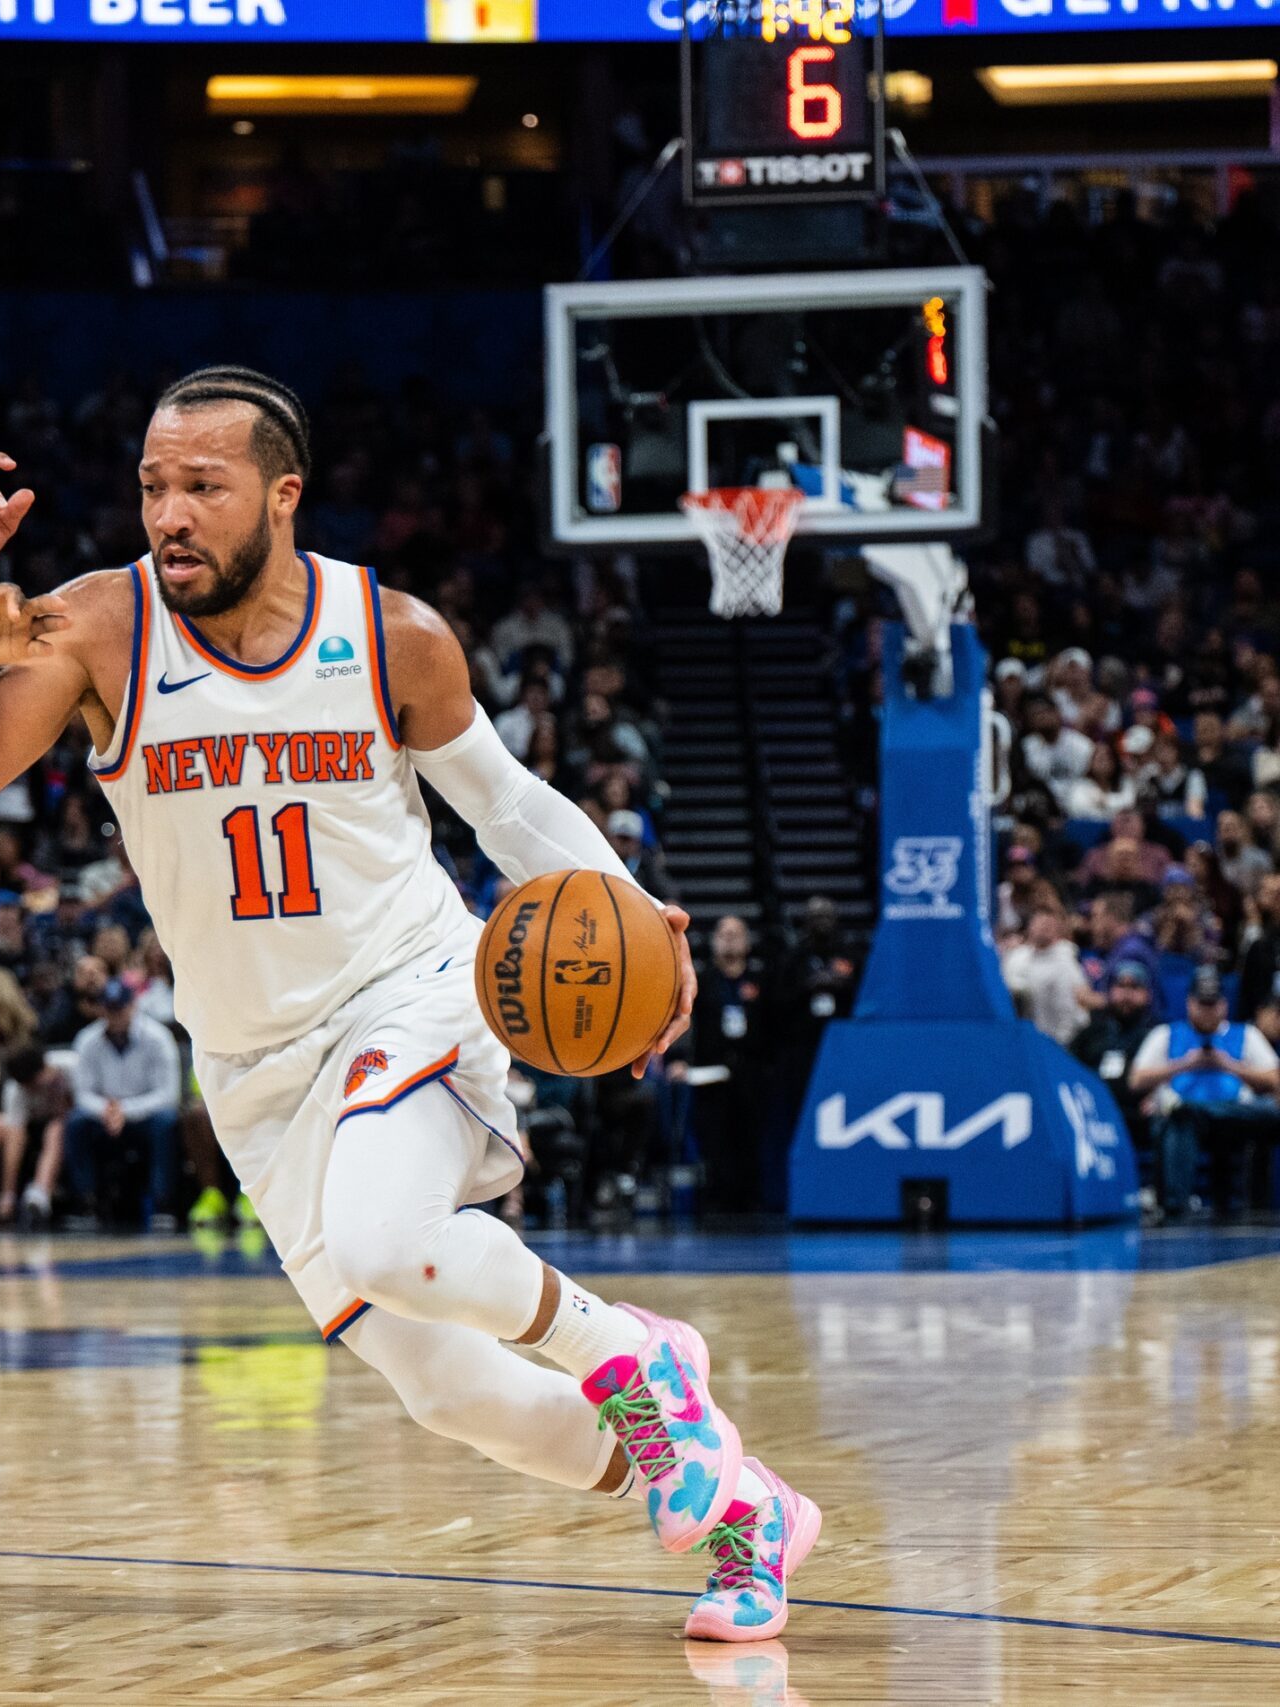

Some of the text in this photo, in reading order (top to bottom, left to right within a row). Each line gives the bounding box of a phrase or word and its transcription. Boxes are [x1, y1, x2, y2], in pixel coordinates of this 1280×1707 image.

[787, 46, 842, 138] 6
[744, 153, 871, 186] TISSOT
[315, 663, 362, 680] sphere
[142, 731, 376, 795] NEW YORK
[221, 801, 322, 921] 11
[494, 901, 542, 1036] Wilson
